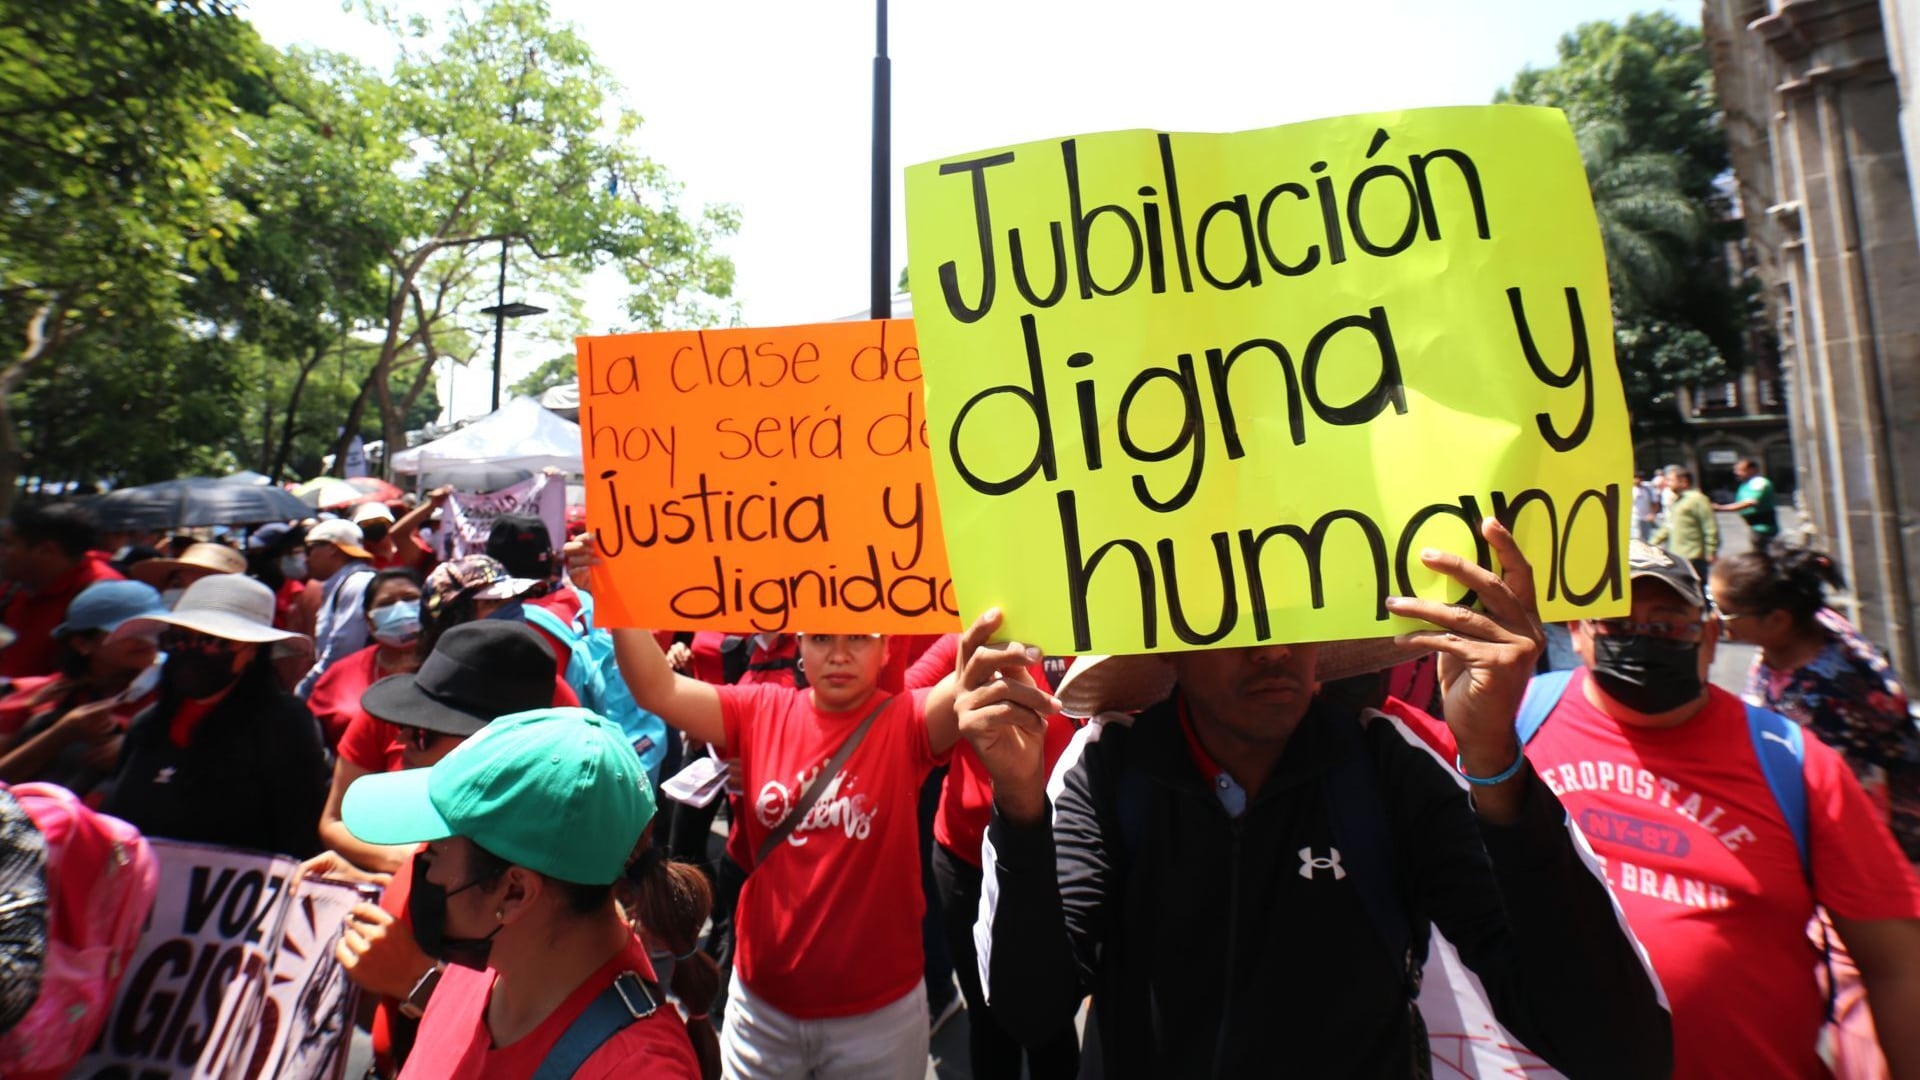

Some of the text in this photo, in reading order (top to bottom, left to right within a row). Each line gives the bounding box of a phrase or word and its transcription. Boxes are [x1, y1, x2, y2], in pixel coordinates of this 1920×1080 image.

[938, 128, 1491, 323] Jubilación
[588, 320, 923, 396] La clase de
[949, 287, 1594, 513] digna y
[588, 406, 676, 488] hoy
[715, 405, 843, 460] será
[882, 483, 923, 571] y
[1056, 483, 1623, 652] humana
[1541, 760, 1758, 852] EROPOSTALE
